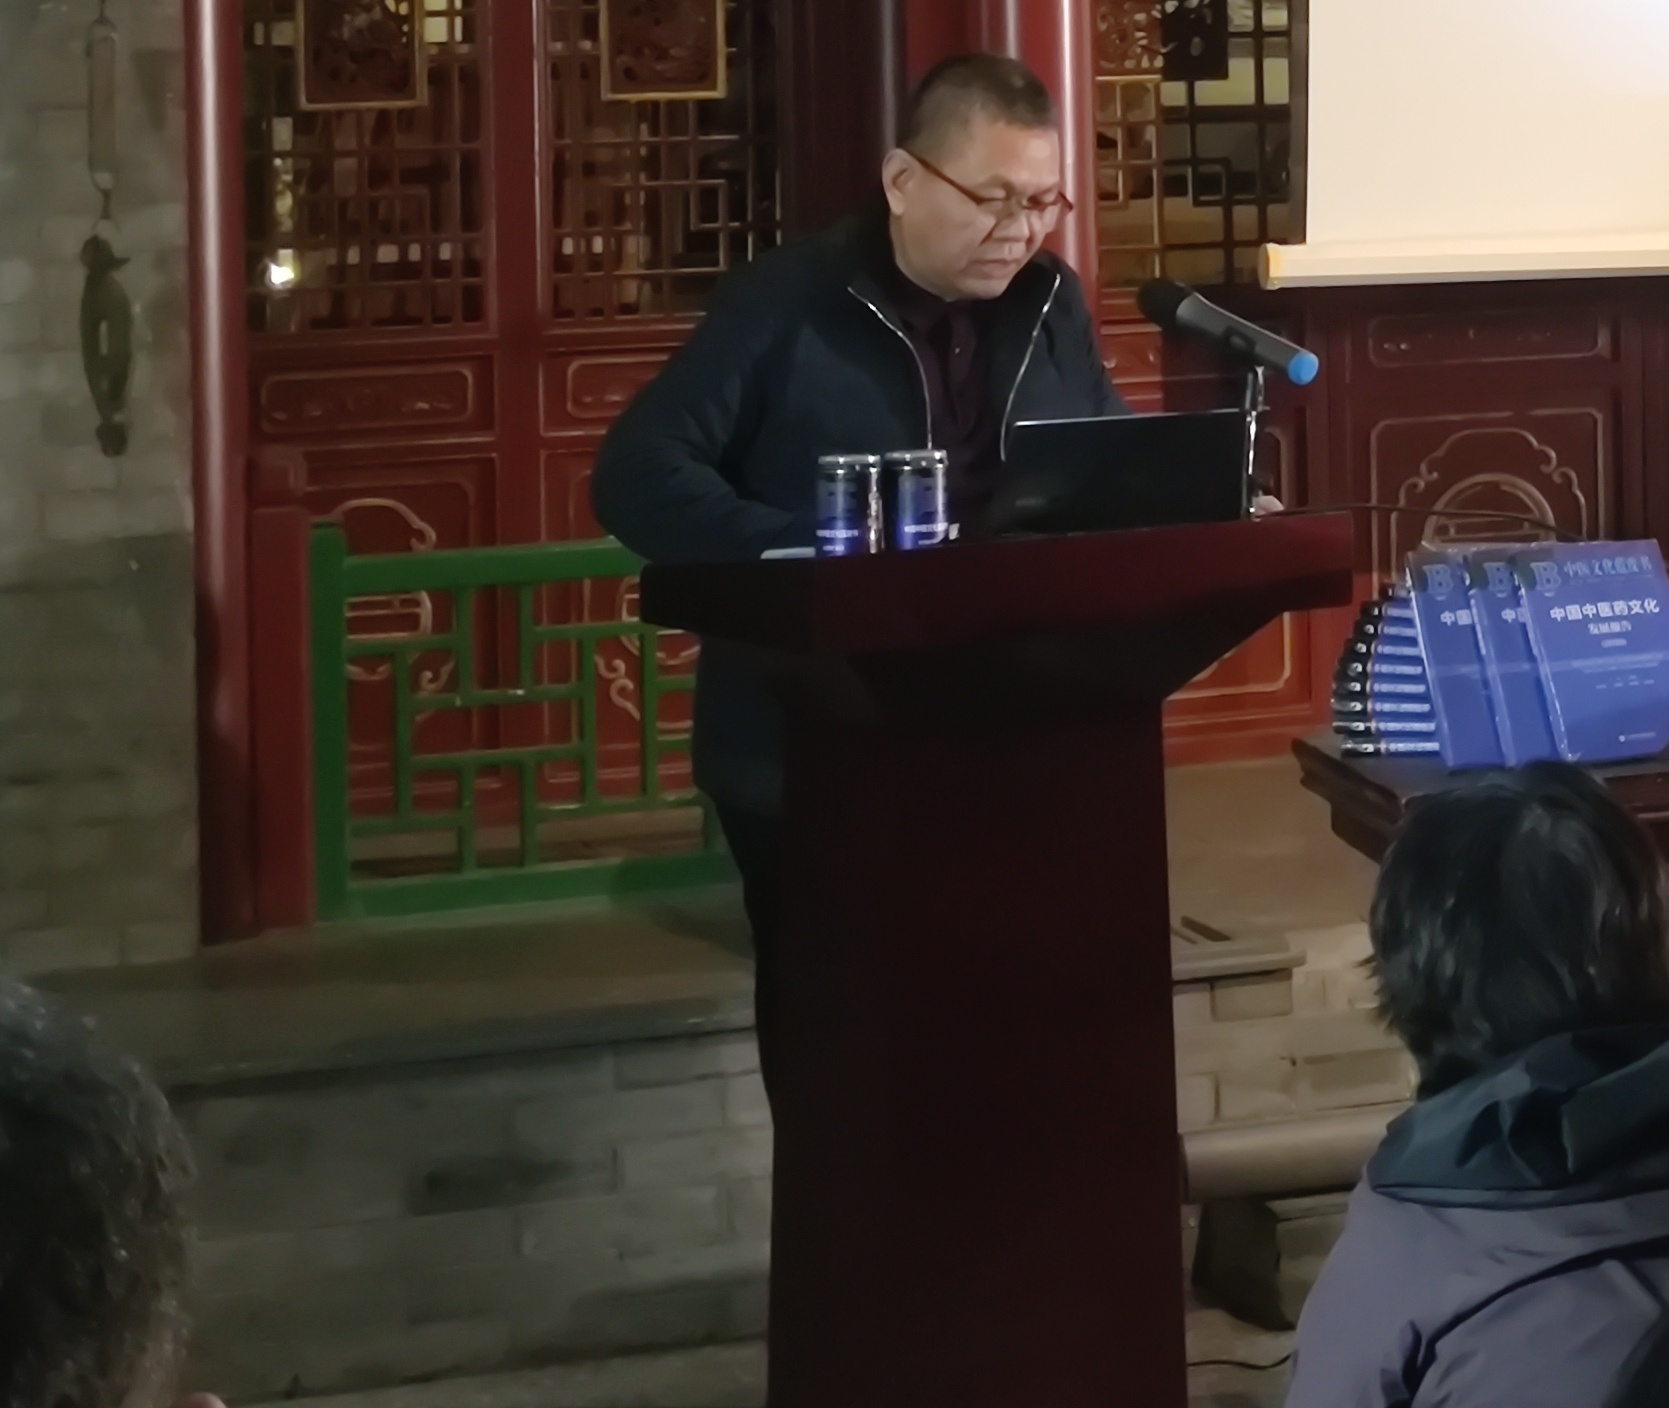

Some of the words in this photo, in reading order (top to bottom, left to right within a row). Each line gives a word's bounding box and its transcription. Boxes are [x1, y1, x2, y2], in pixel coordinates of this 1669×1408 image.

[1549, 596, 1660, 623] 中国中医药文化
